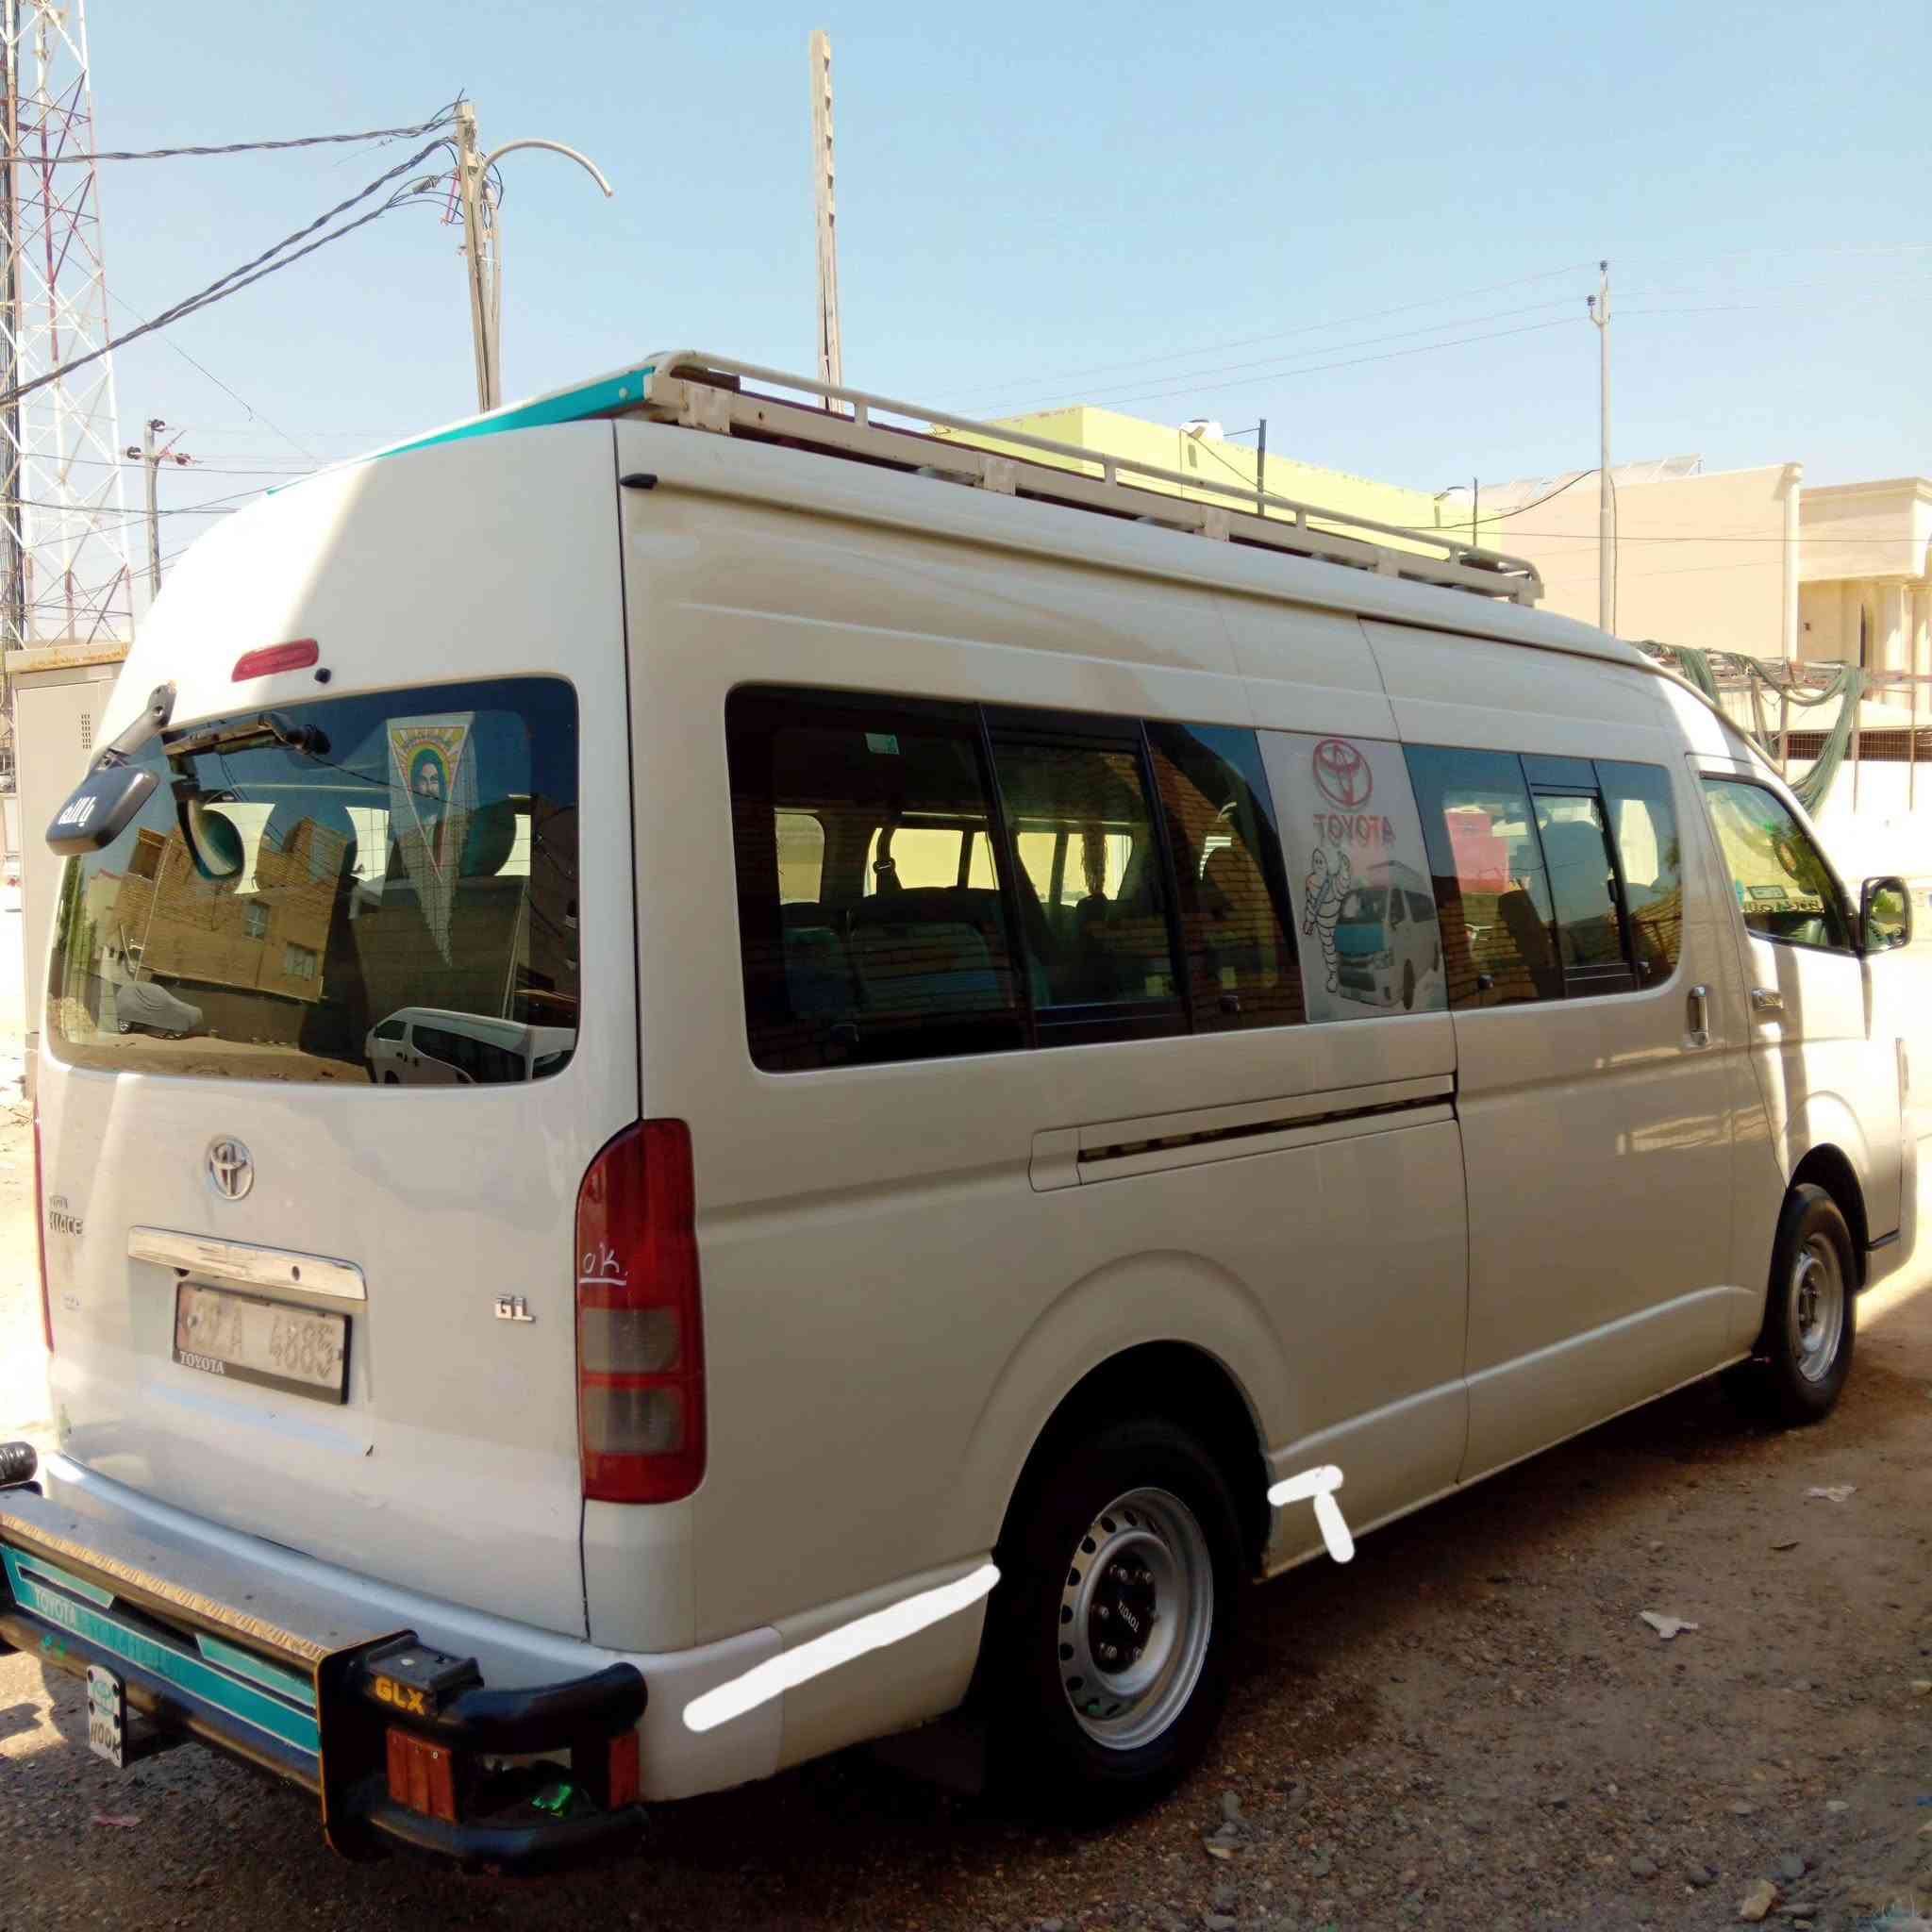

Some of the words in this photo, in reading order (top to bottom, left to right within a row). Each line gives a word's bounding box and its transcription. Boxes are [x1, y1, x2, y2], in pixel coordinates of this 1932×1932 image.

[1313, 814, 1396, 847] TOYOTA
[494, 1294, 536, 1323] GL
[180, 1351, 225, 1374] TOYOTA
[376, 1675, 425, 1716] GLX
[91, 1723, 122, 1760] HOOK
